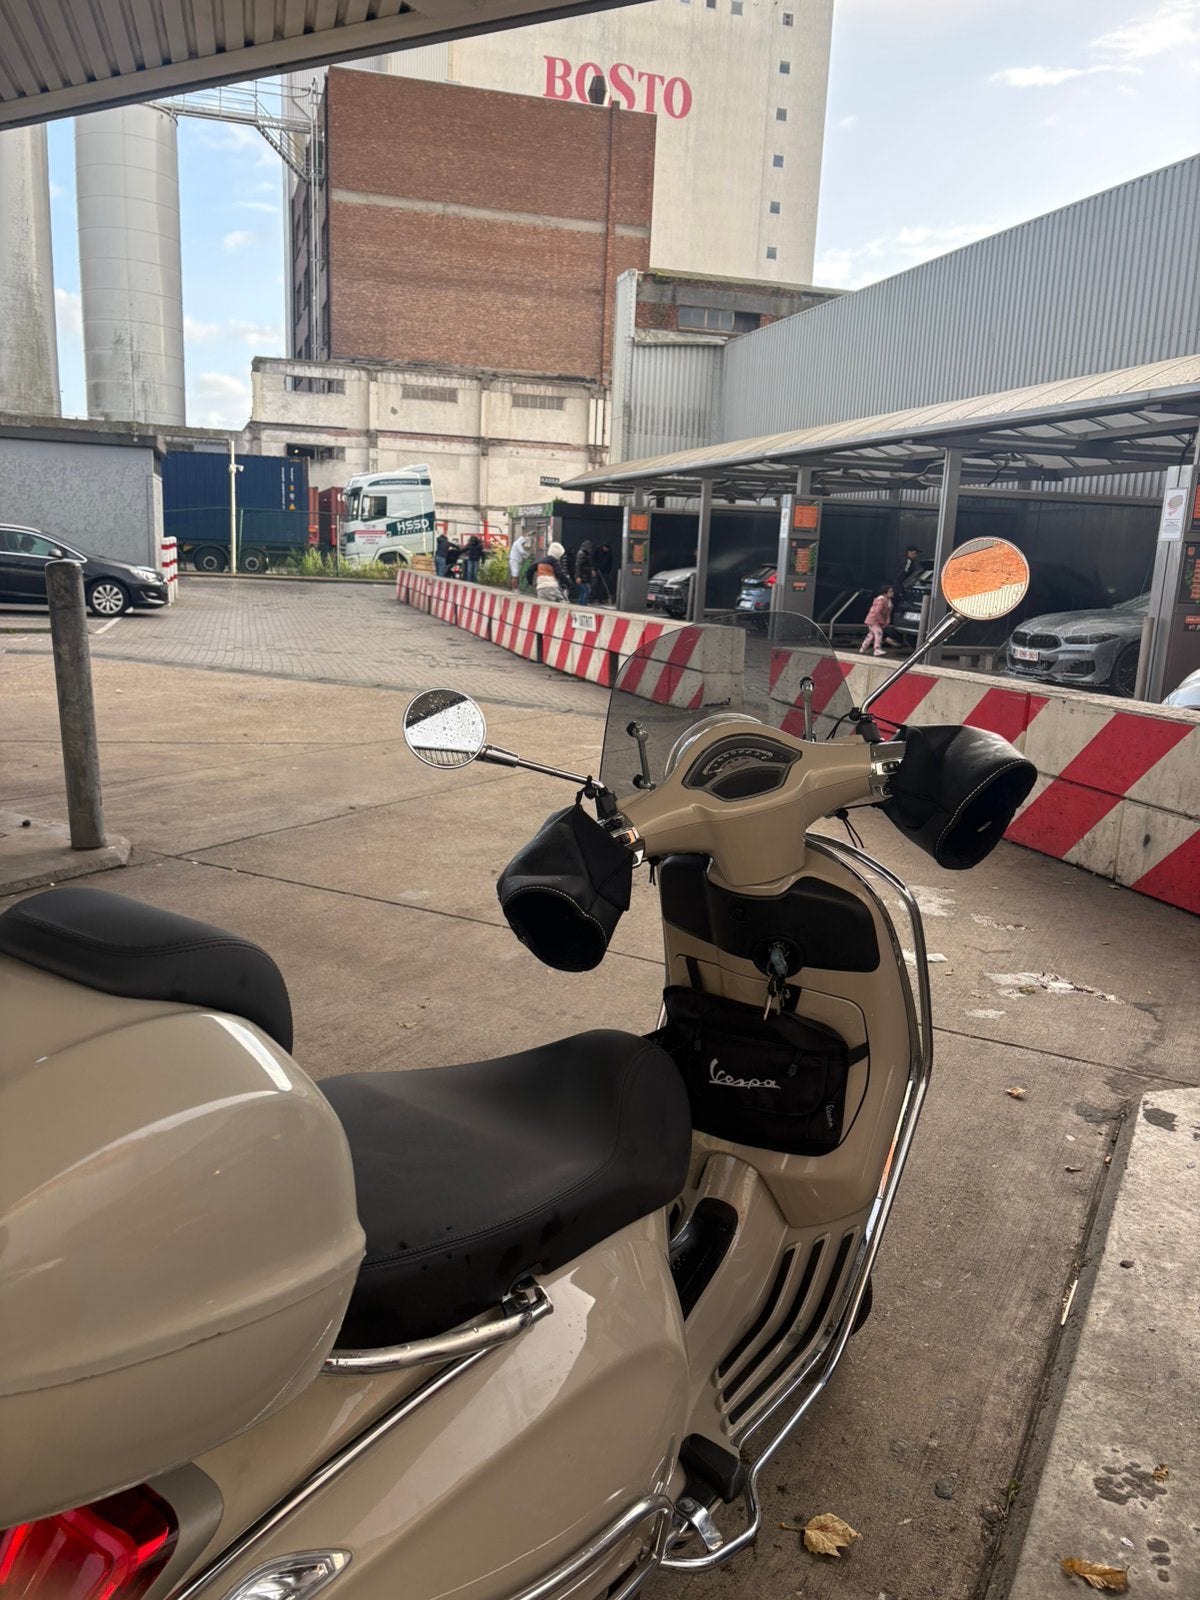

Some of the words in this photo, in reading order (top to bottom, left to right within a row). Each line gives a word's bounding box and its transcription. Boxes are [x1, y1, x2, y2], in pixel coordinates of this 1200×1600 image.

[543, 55, 692, 119] BOSTO
[397, 518, 430, 531] HSSD
[709, 1058, 781, 1089] Vespa
